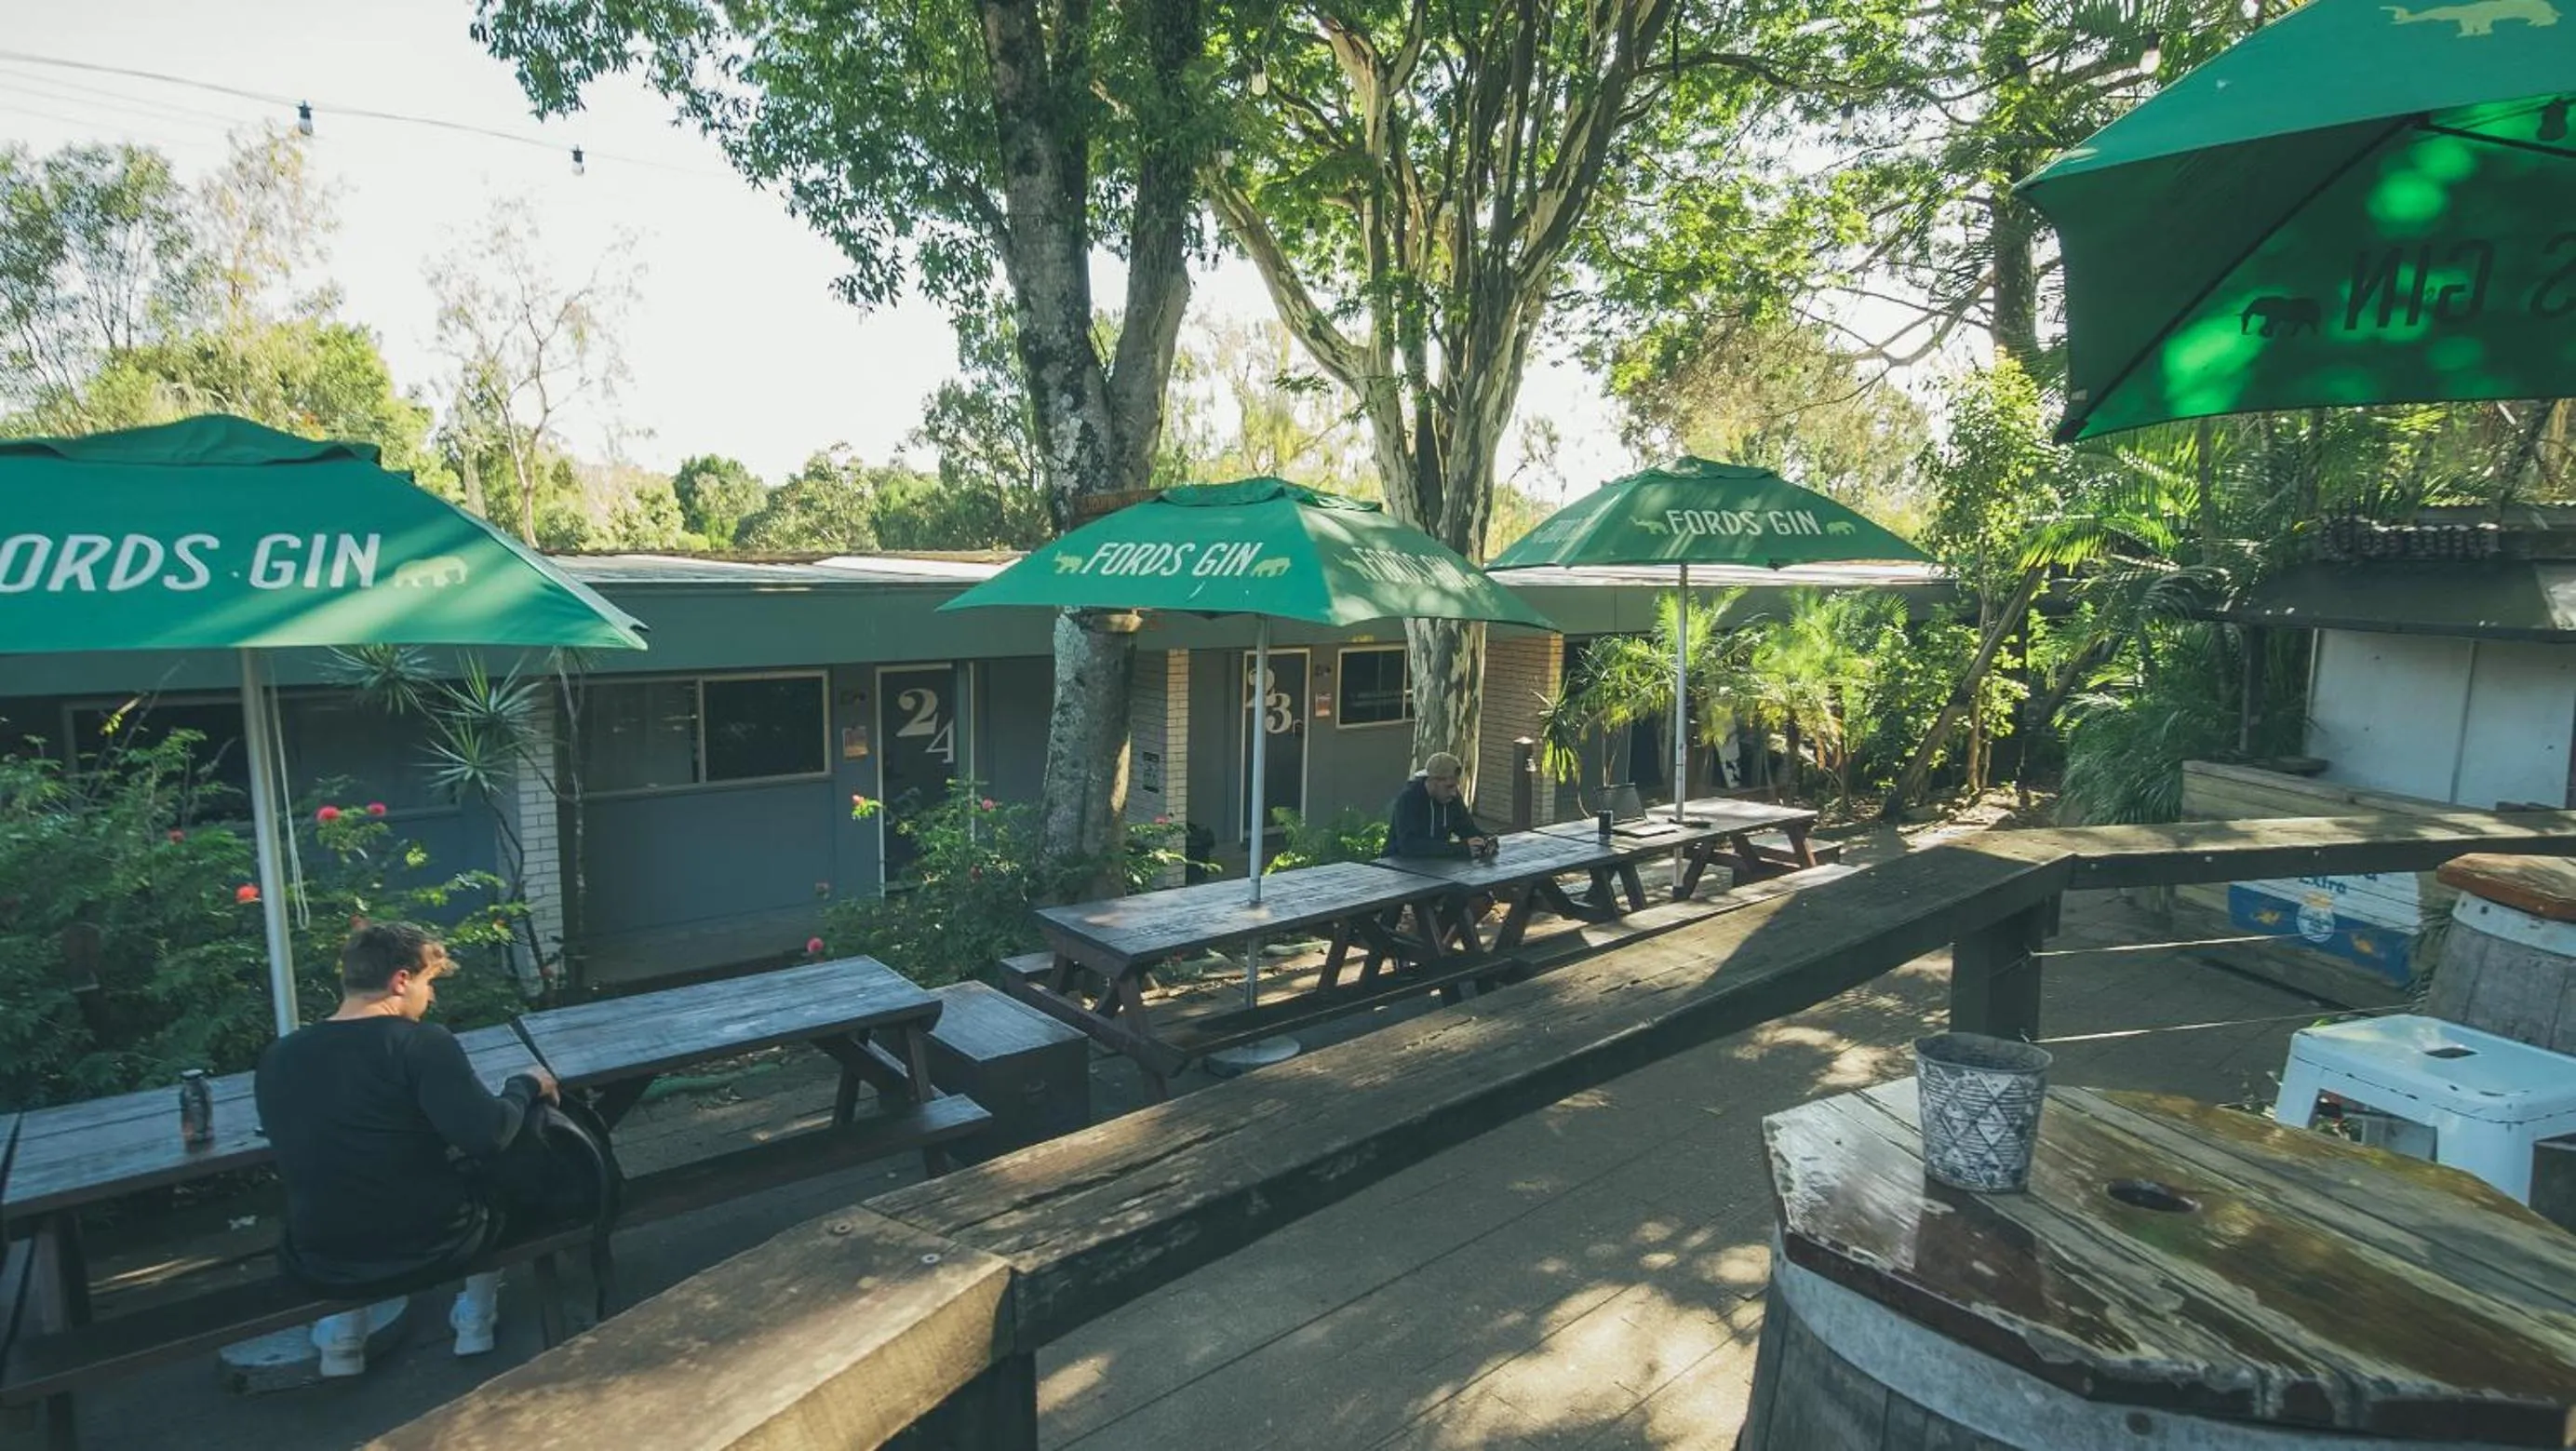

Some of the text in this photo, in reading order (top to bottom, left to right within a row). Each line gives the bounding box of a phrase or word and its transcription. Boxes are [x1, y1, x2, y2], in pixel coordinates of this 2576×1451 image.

[1665, 509, 1822, 536] FORDS GIN
[0, 532, 382, 593] ORDS GIN
[1080, 542, 1265, 577] FORDS GIN
[895, 688, 955, 764] 24
